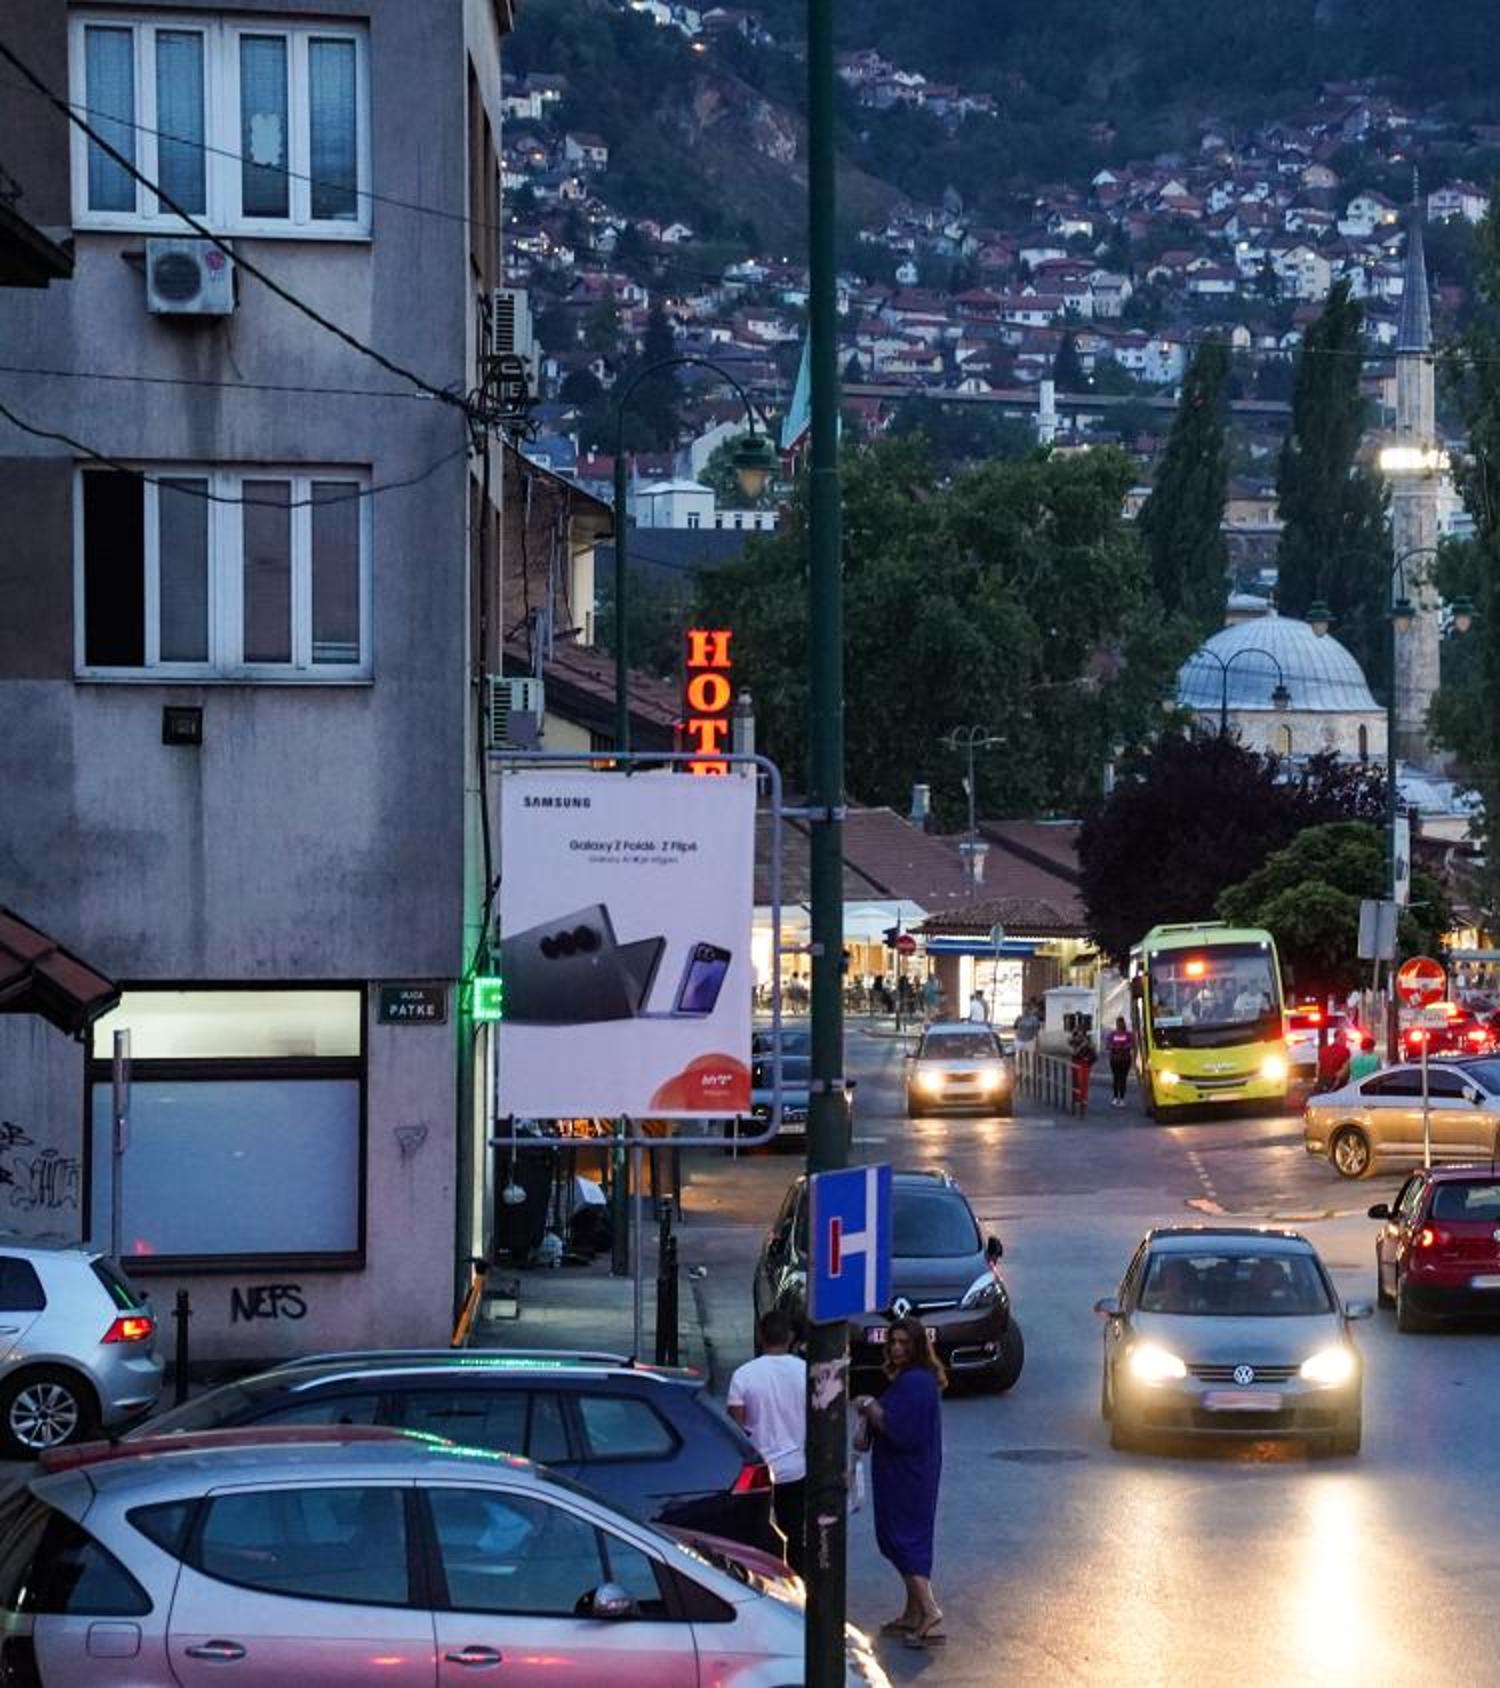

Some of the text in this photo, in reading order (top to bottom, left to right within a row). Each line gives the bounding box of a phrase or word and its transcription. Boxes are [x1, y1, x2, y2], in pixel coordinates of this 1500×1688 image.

[523, 796, 591, 808] SAMSUNG
[569, 839, 611, 853] Galaxy
[389, 1004, 435, 1016] PATKE
